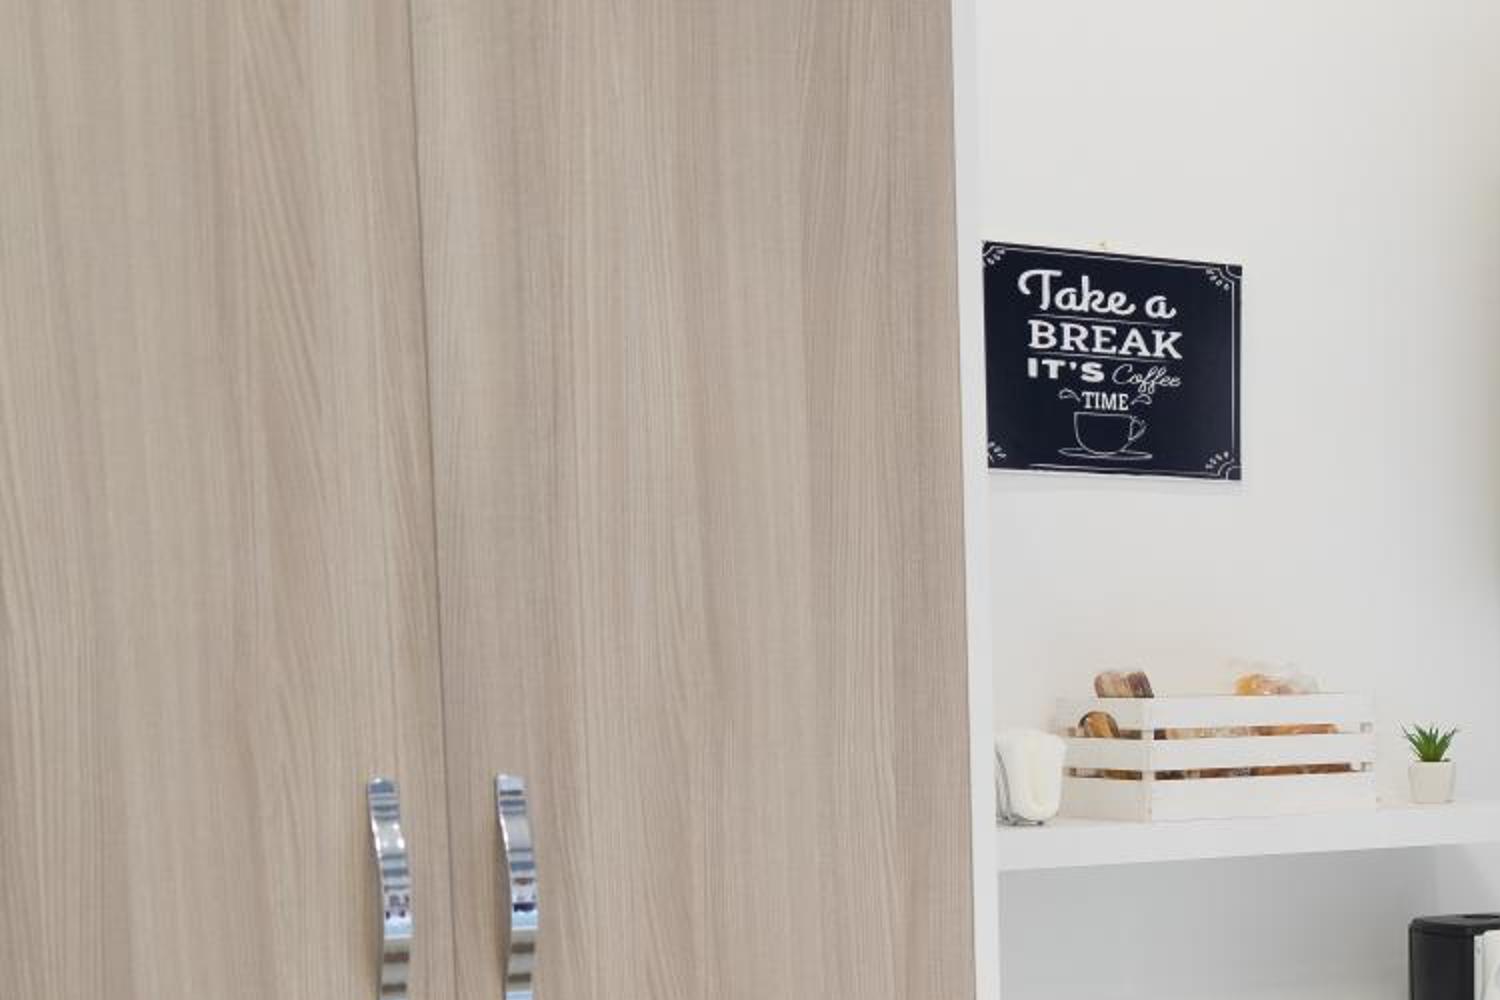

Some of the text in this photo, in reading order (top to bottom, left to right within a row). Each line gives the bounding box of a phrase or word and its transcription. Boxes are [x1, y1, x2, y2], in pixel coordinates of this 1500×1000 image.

[1017, 269, 1177, 319] Take a
[1027, 320, 1183, 359] BREAK
[1027, 358, 1182, 394] IT'S Coffee
[1082, 391, 1129, 411] TIME
